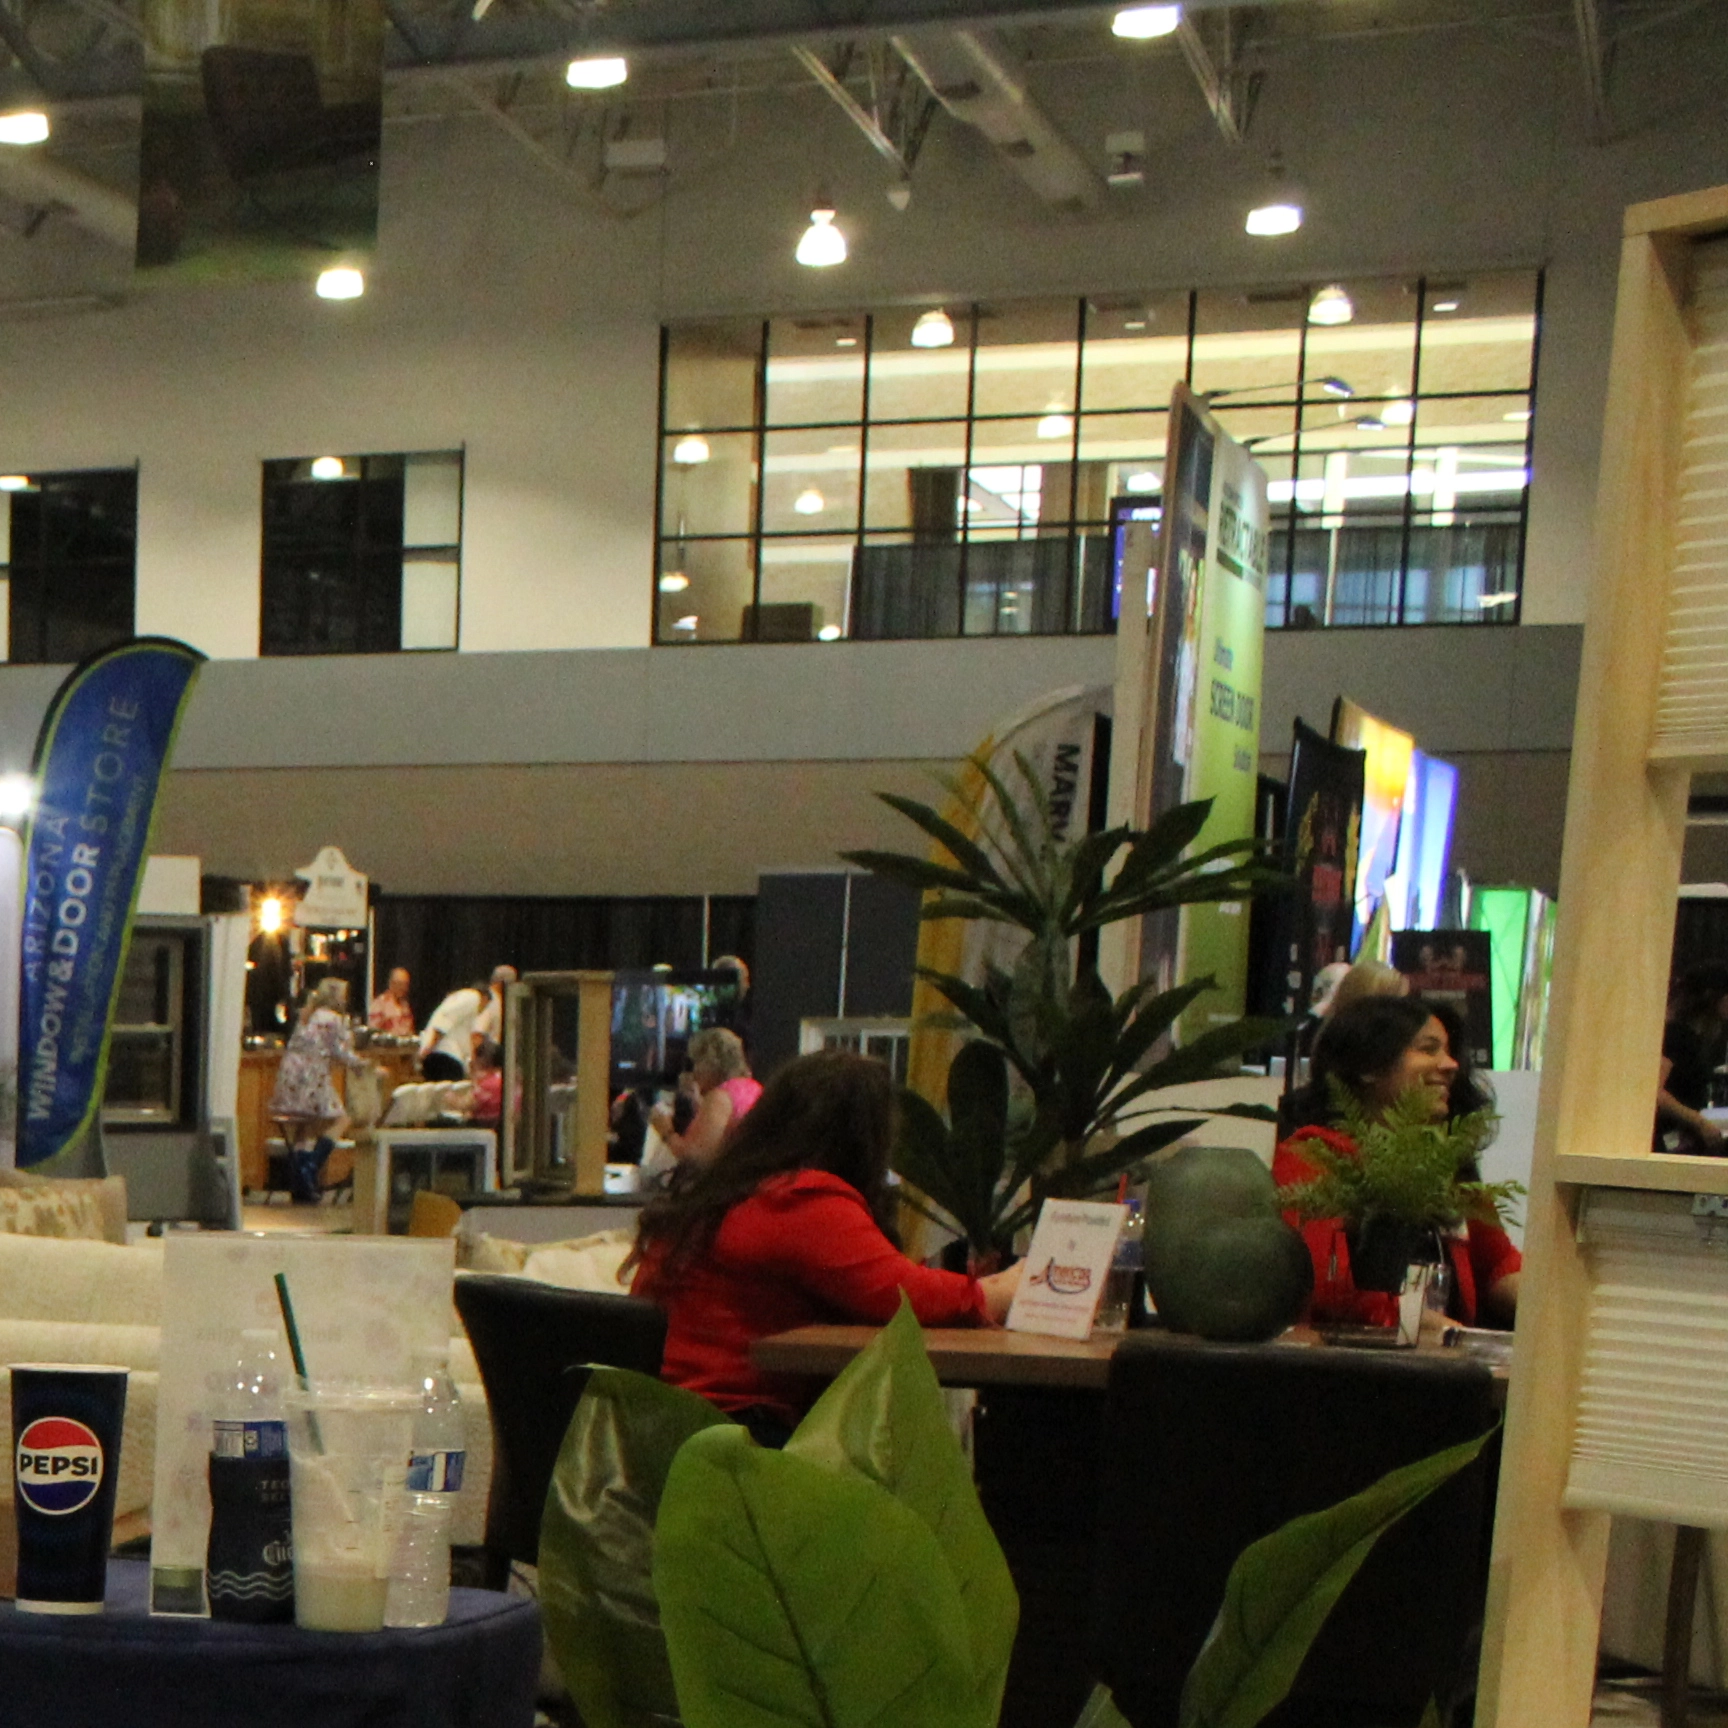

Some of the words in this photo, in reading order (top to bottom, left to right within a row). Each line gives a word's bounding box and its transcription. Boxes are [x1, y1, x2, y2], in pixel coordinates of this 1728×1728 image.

[79, 695, 140, 834] STORE
[23, 816, 70, 982] ARIZONA
[20, 1454, 98, 1476] PEPSI
